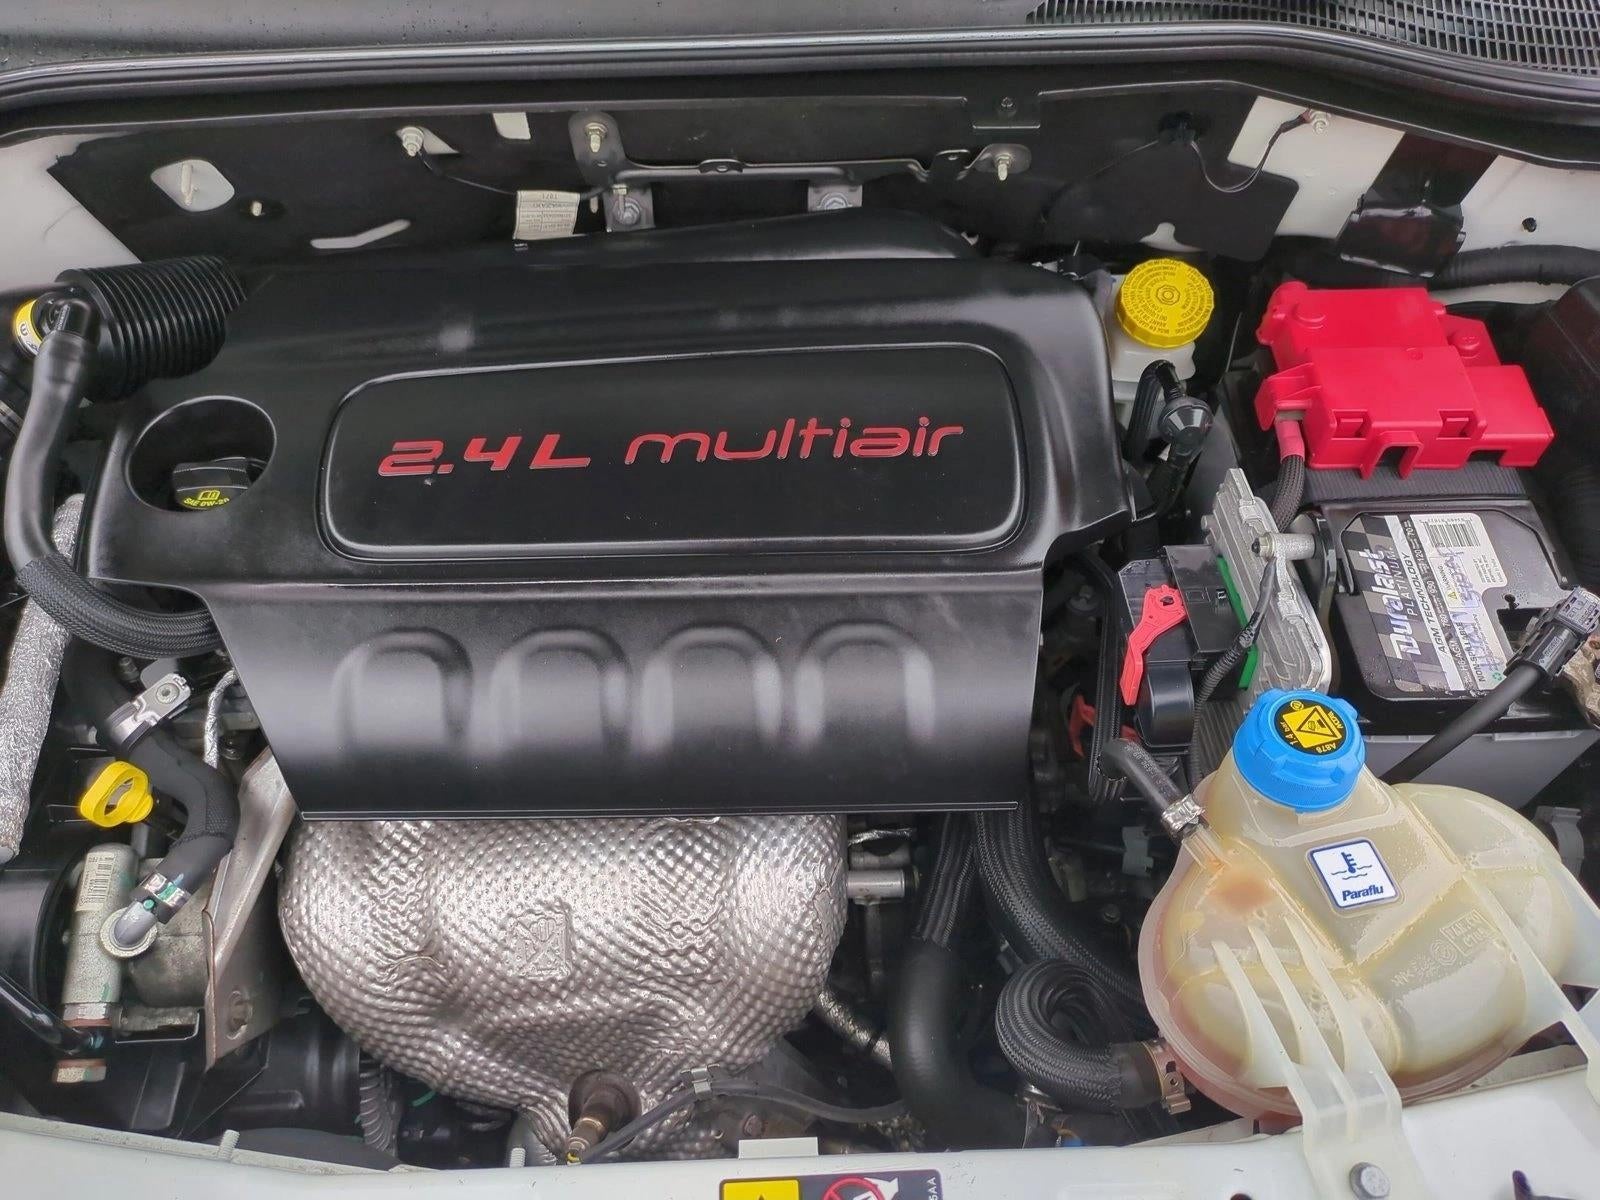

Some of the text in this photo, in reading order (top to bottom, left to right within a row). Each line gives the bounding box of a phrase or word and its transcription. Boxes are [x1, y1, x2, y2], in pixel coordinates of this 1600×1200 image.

[624, 416, 964, 465] multiair
[183, 497, 200, 507] SAE
[1413, 549, 1425, 562] 120
[1386, 551, 1418, 617] PLATINUM
[1402, 552, 1439, 624] TECHNOLOGY
[1358, 549, 1422, 659] Duralast
[1429, 628, 1448, 654] AGM
[1341, 884, 1384, 902] Paraflu
